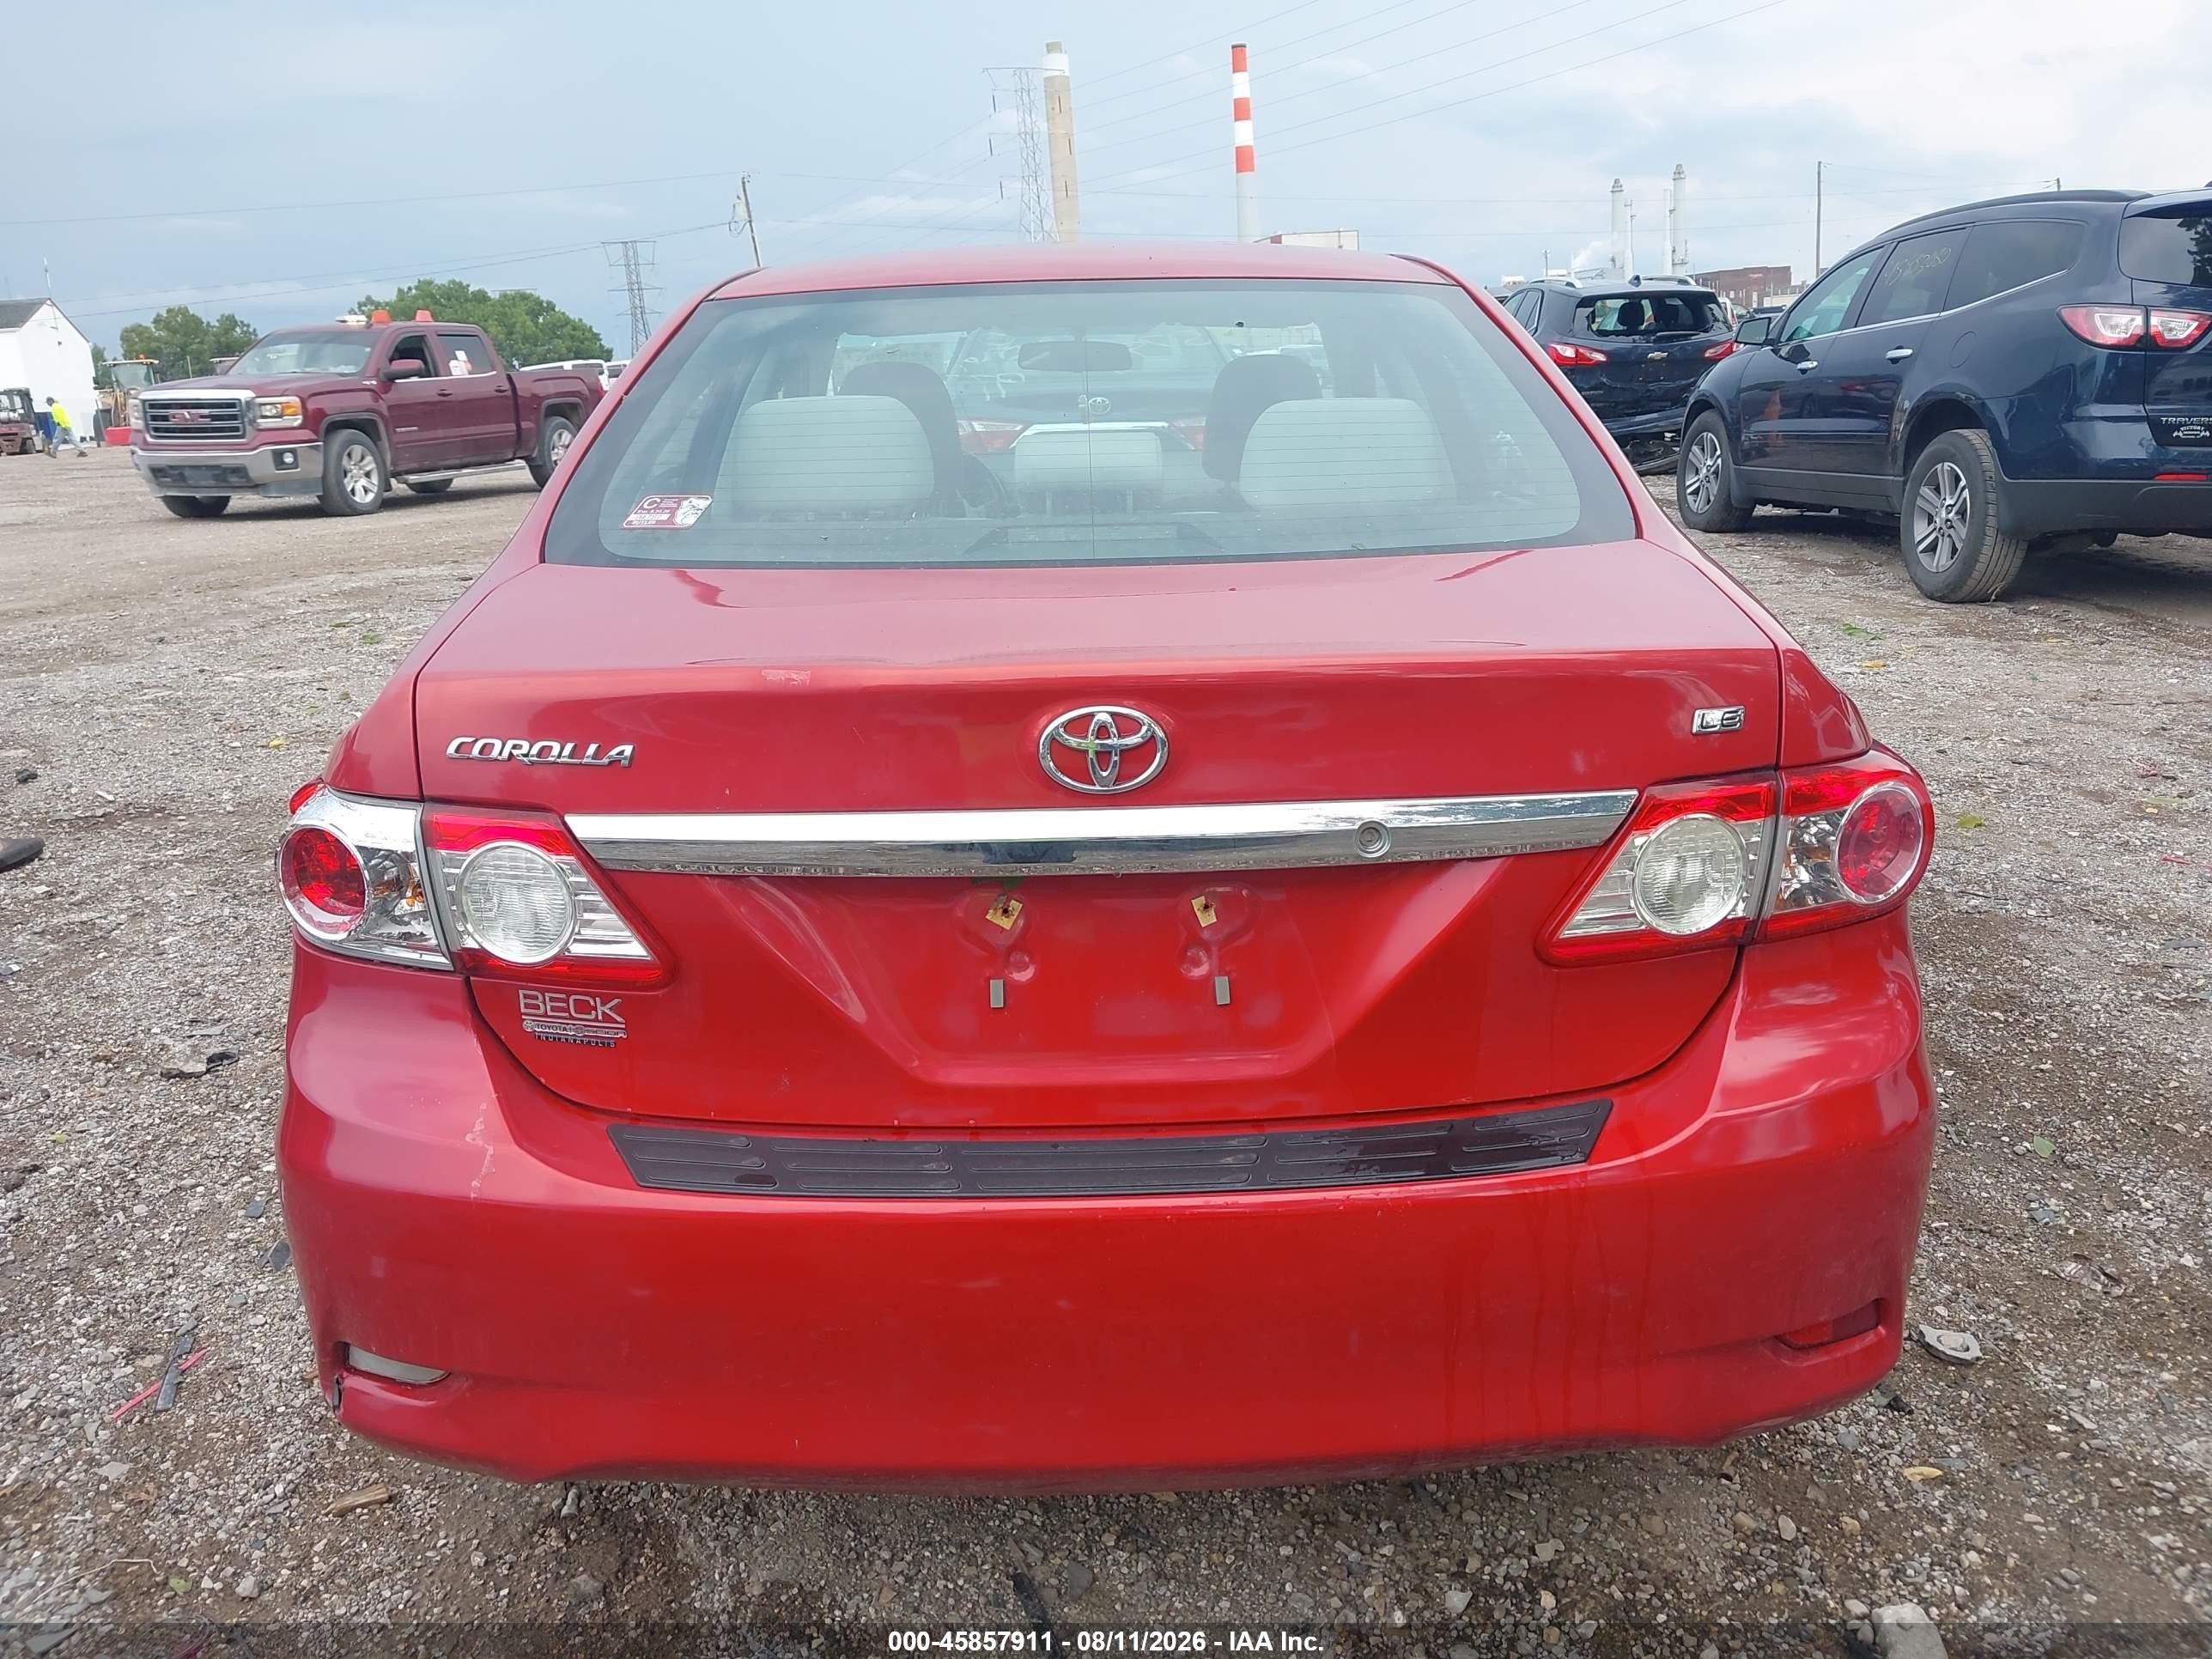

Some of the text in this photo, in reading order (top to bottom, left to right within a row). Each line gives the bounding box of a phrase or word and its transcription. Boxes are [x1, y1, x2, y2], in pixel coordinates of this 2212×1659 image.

[1692, 706, 1746, 735] LE
[446, 736, 635, 769] COROLLA
[519, 989, 626, 1024] BECK
[535, 1034, 616, 1048] INDIANAPOLIS
[536, 1023, 568, 1032] TOYOTA
